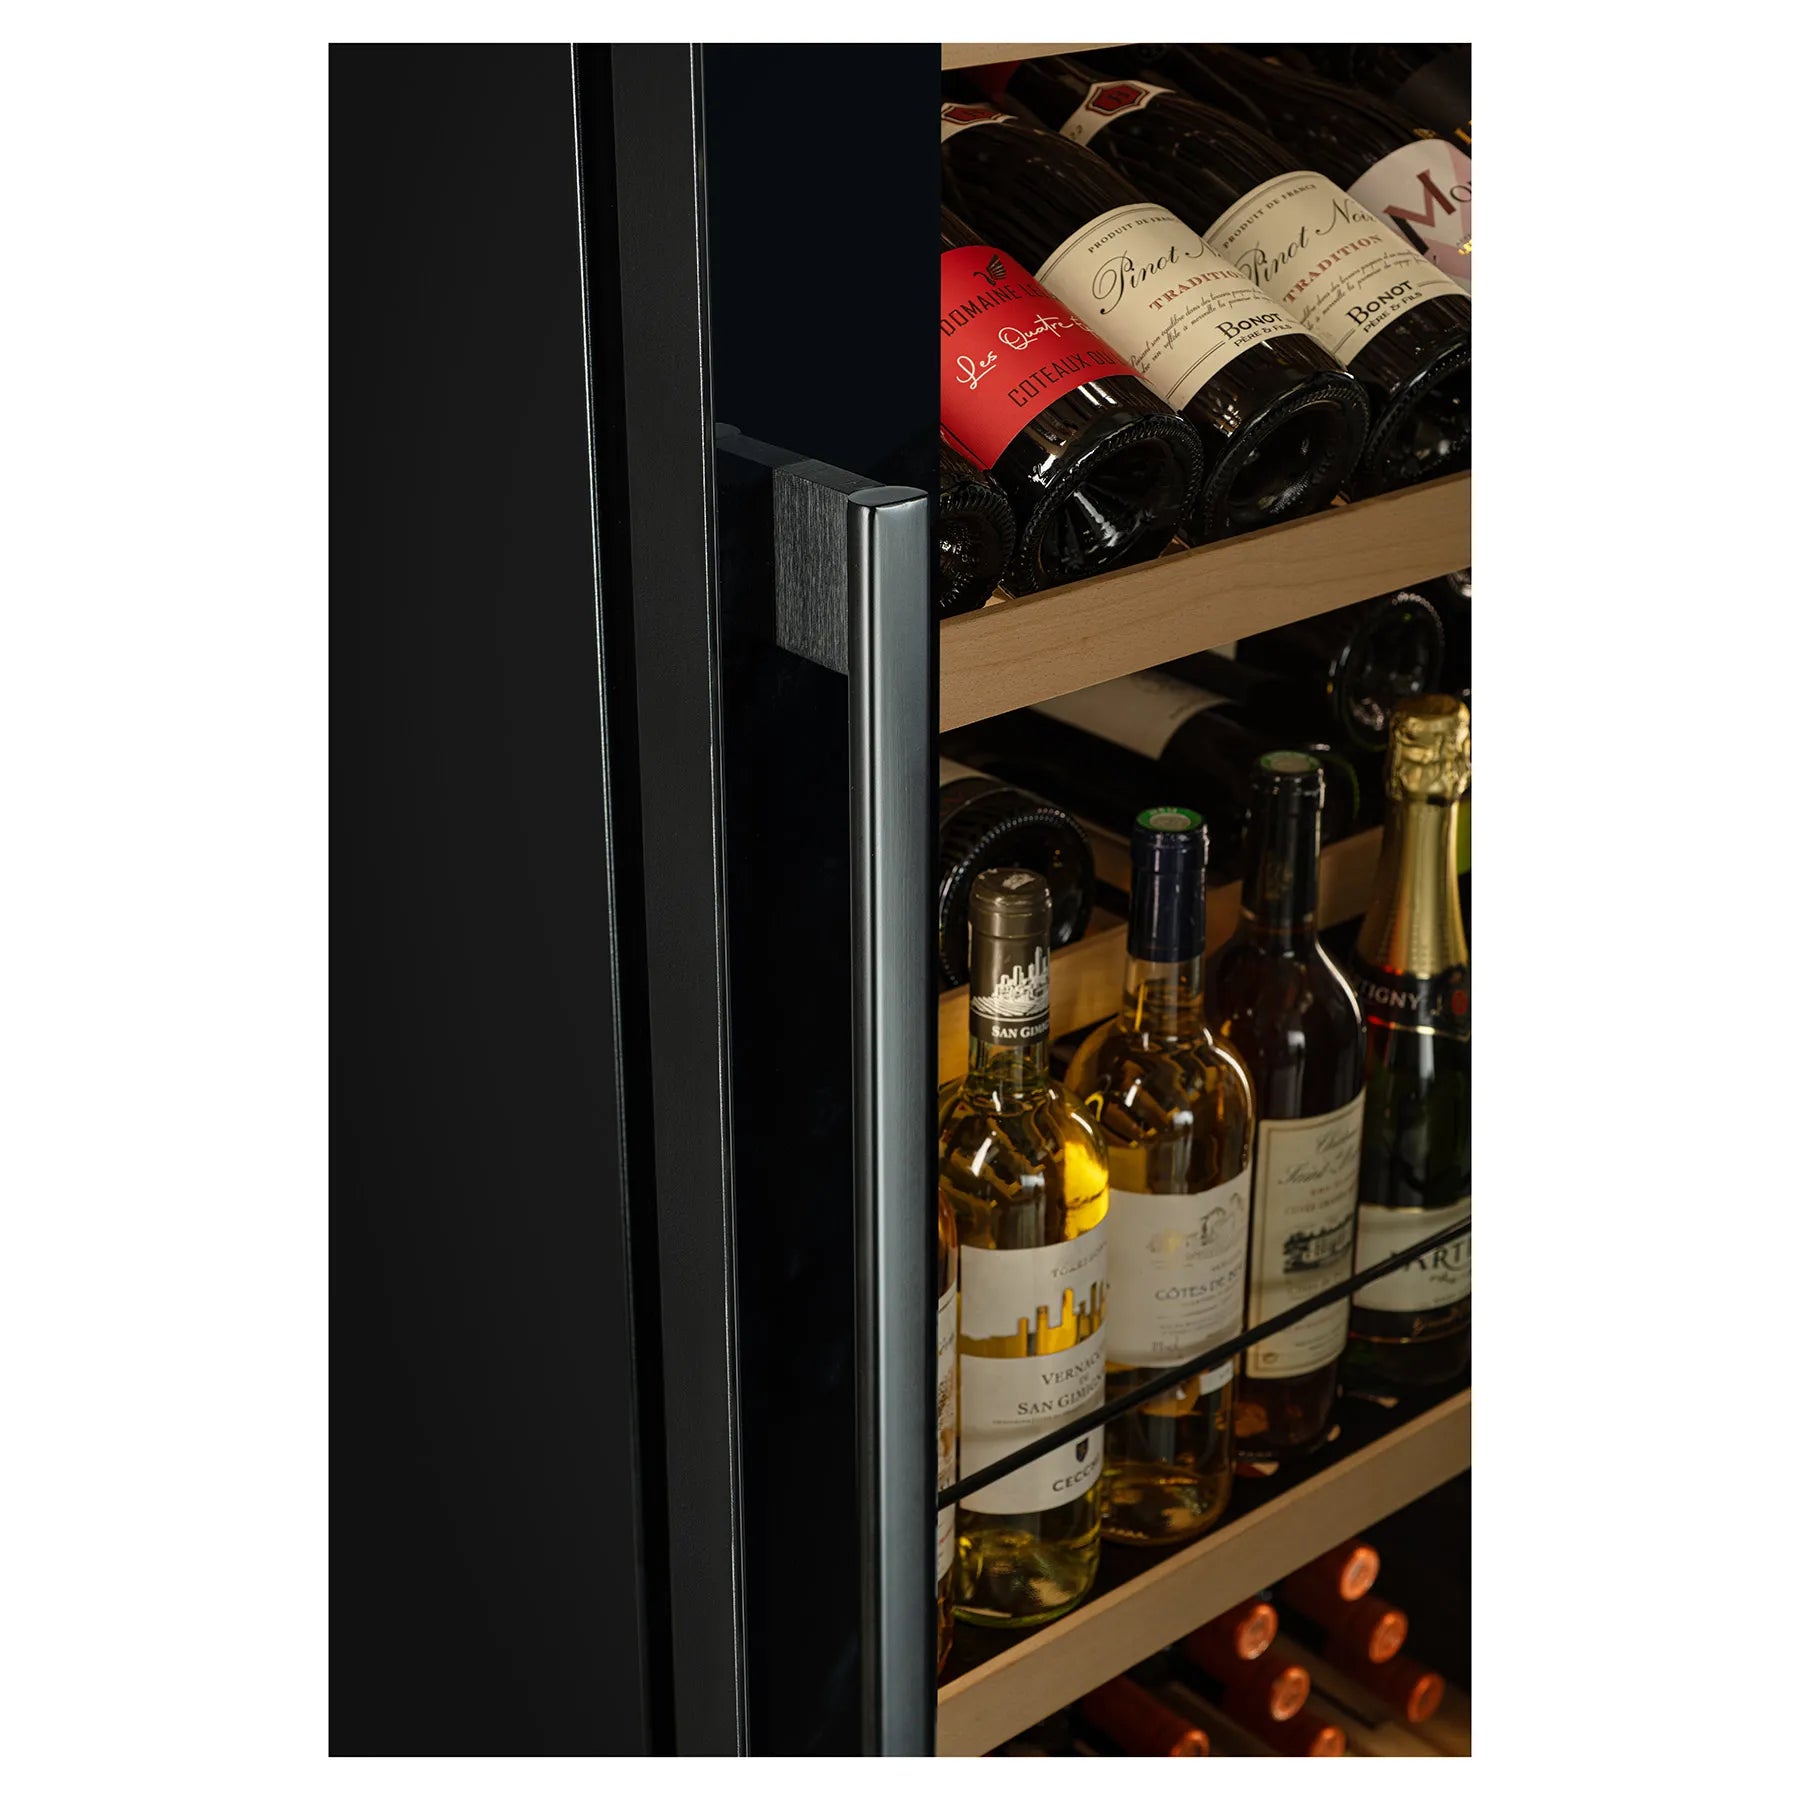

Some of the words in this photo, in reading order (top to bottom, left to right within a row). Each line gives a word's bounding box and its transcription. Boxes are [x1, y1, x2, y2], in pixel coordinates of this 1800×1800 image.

[1088, 223, 1132, 253] PRODUIT
[1135, 217, 1149, 227] DE
[1222, 208, 1264, 248] PRODUIT
[1266, 199, 1281, 209] DE
[1282, 184, 1317, 200] FRANCE
[1234, 225, 1309, 287] Pinot
[1315, 198, 1378, 236] Noir
[1092, 246, 1180, 315] Pinot
[1284, 234, 1384, 304] TRADITION
[940, 285, 1022, 336] DOMAINE
[1215, 312, 1285, 340] BONOT
[1345, 280, 1414, 326] BONOT
[1363, 310, 1390, 333] PÈRE
[1390, 303, 1401, 312] &
[1401, 291, 1423, 305] FILS
[956, 351, 998, 390] Les
[998, 314, 1074, 351] Quatre
[1233, 330, 1260, 348] PÈRE
[1261, 326, 1272, 334] &
[1273, 323, 1293, 332] FILS
[1008, 353, 1090, 408] COTEAUX
[992, 1024, 1018, 1039] SAN
[1155, 1284, 1208, 1301] CÔTES
[1017, 1400, 1054, 1416] SAN
